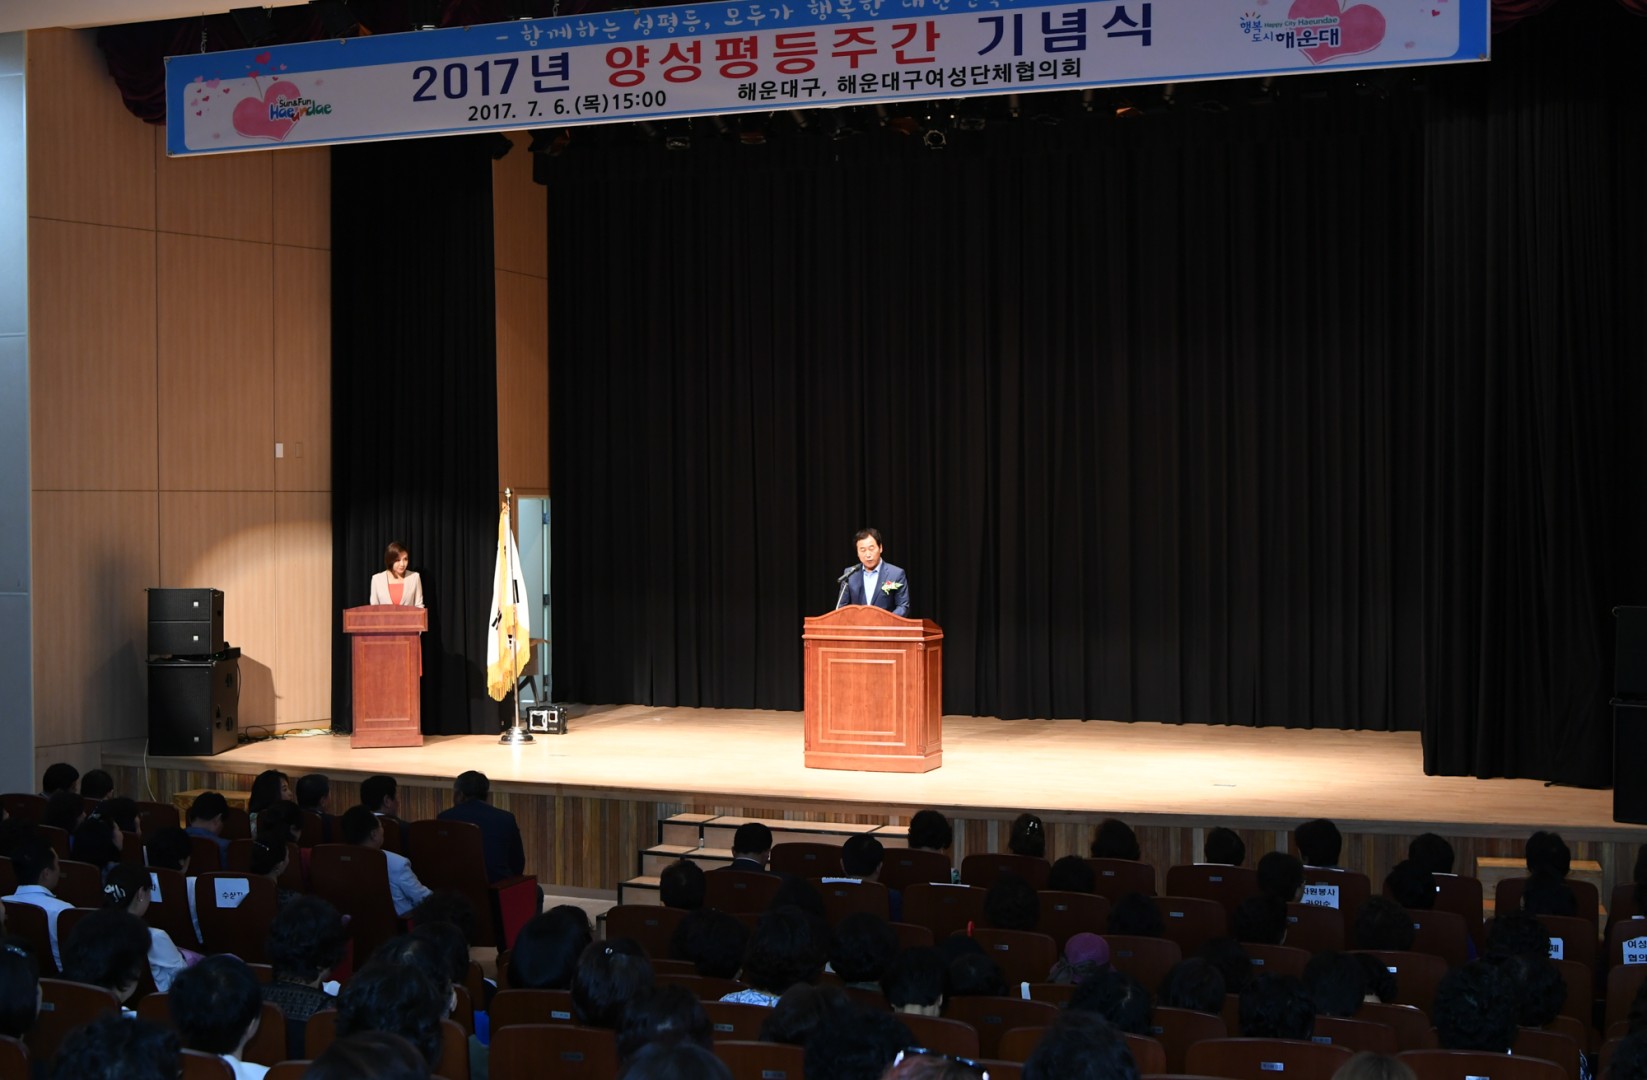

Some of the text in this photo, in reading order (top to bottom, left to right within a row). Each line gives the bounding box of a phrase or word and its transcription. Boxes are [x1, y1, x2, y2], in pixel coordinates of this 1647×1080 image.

[521, 18, 620, 47] 함께하는
[633, 9, 710, 36] 성평등,
[723, 4, 794, 27] 모두가
[1240, 20, 1262, 34] 행복
[1298, 16, 1338, 26] Haeundae
[1251, 28, 1339, 49] 도시 해운대
[412, 2, 1153, 102] 2017년 양성평등주간 기념식
[737, 57, 1081, 102] 해운대구, 해운대구여성단체협의회
[468, 103, 516, 121] 2017.
[528, 101, 543, 116] 7.
